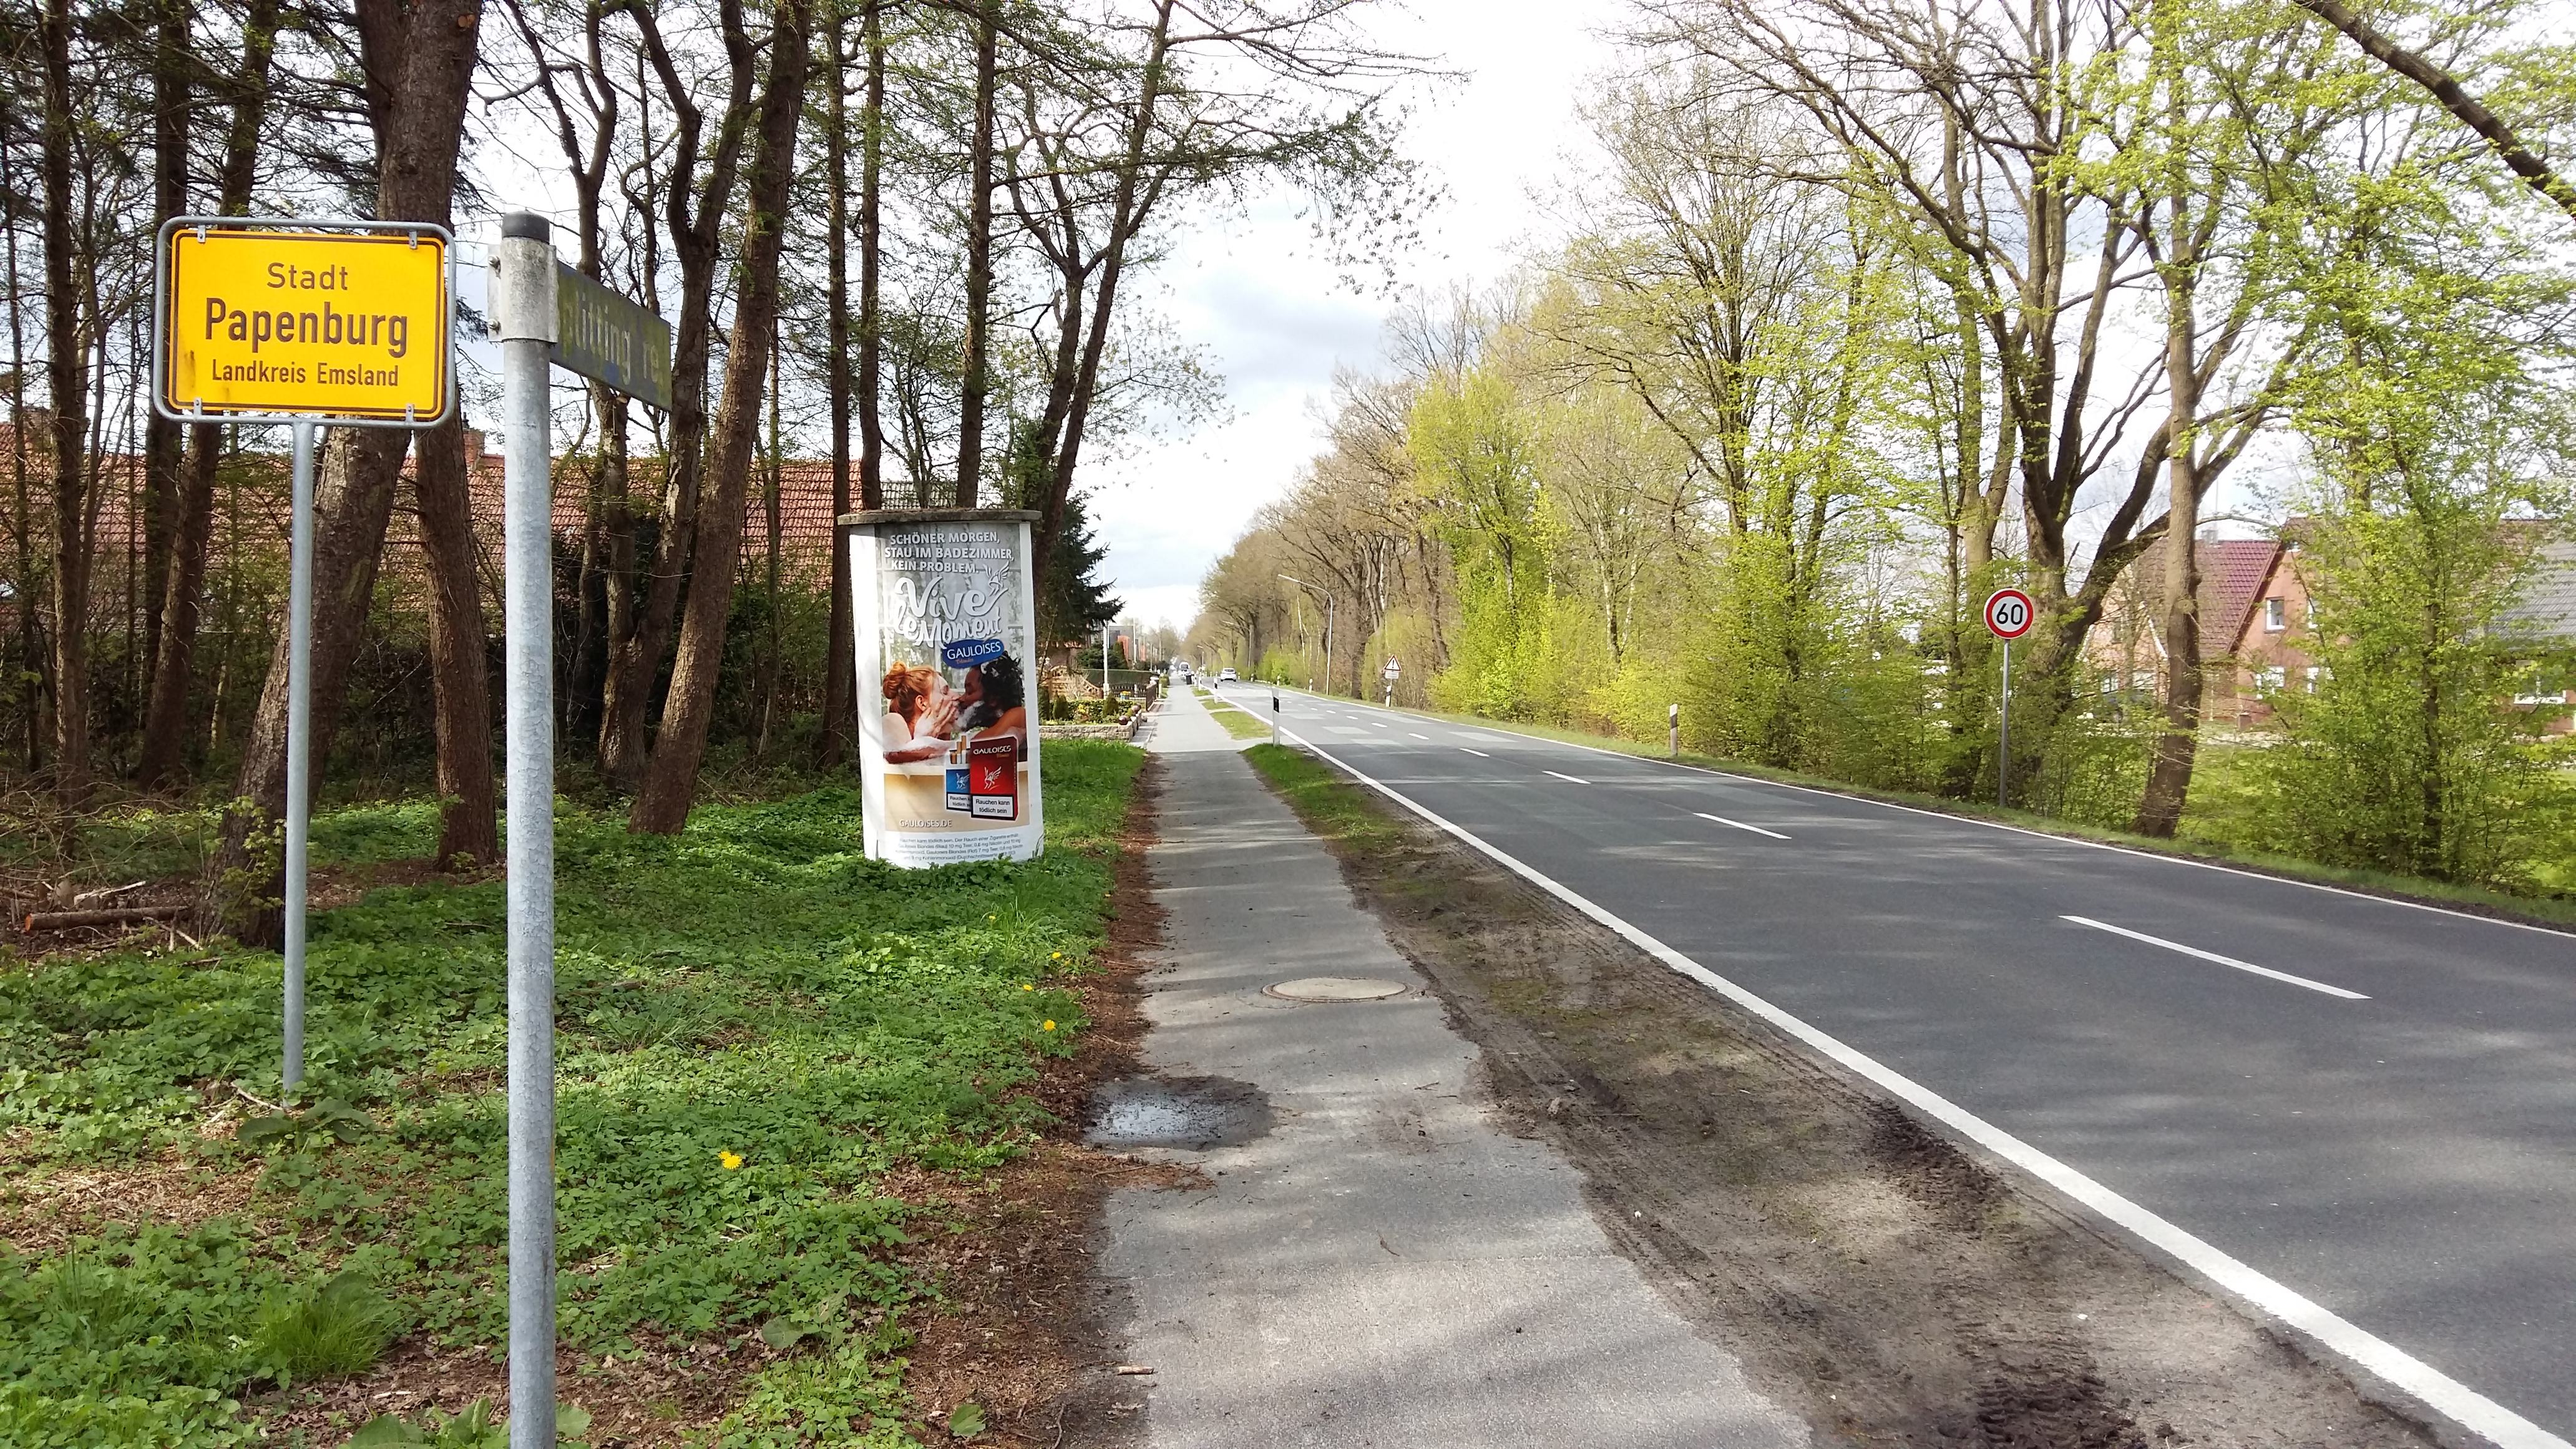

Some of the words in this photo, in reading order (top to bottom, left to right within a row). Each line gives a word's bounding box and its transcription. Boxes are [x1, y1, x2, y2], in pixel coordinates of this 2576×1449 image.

[266, 262, 348, 291] Stadt
[205, 297, 407, 358] Papenburg
[212, 359, 306, 384] Landkreis
[317, 362, 399, 387] Emsland
[890, 531, 945, 545] SCHÖNER
[949, 531, 1000, 544] MORGEN,
[884, 547, 913, 559] STAU
[915, 547, 932, 559] IM
[935, 547, 1015, 562] BADEZIMMER,
[890, 560, 917, 571] KEIN
[919, 561, 980, 573] PROBLEM.
[894, 577, 1008, 620] Vive
[1996, 603, 2023, 625] 60
[913, 607, 1003, 650] Moment
[947, 641, 1002, 660] GAULOISES
[973, 745, 1012, 755] GAULOISES
[899, 819, 953, 827] GAULOISES.DE
